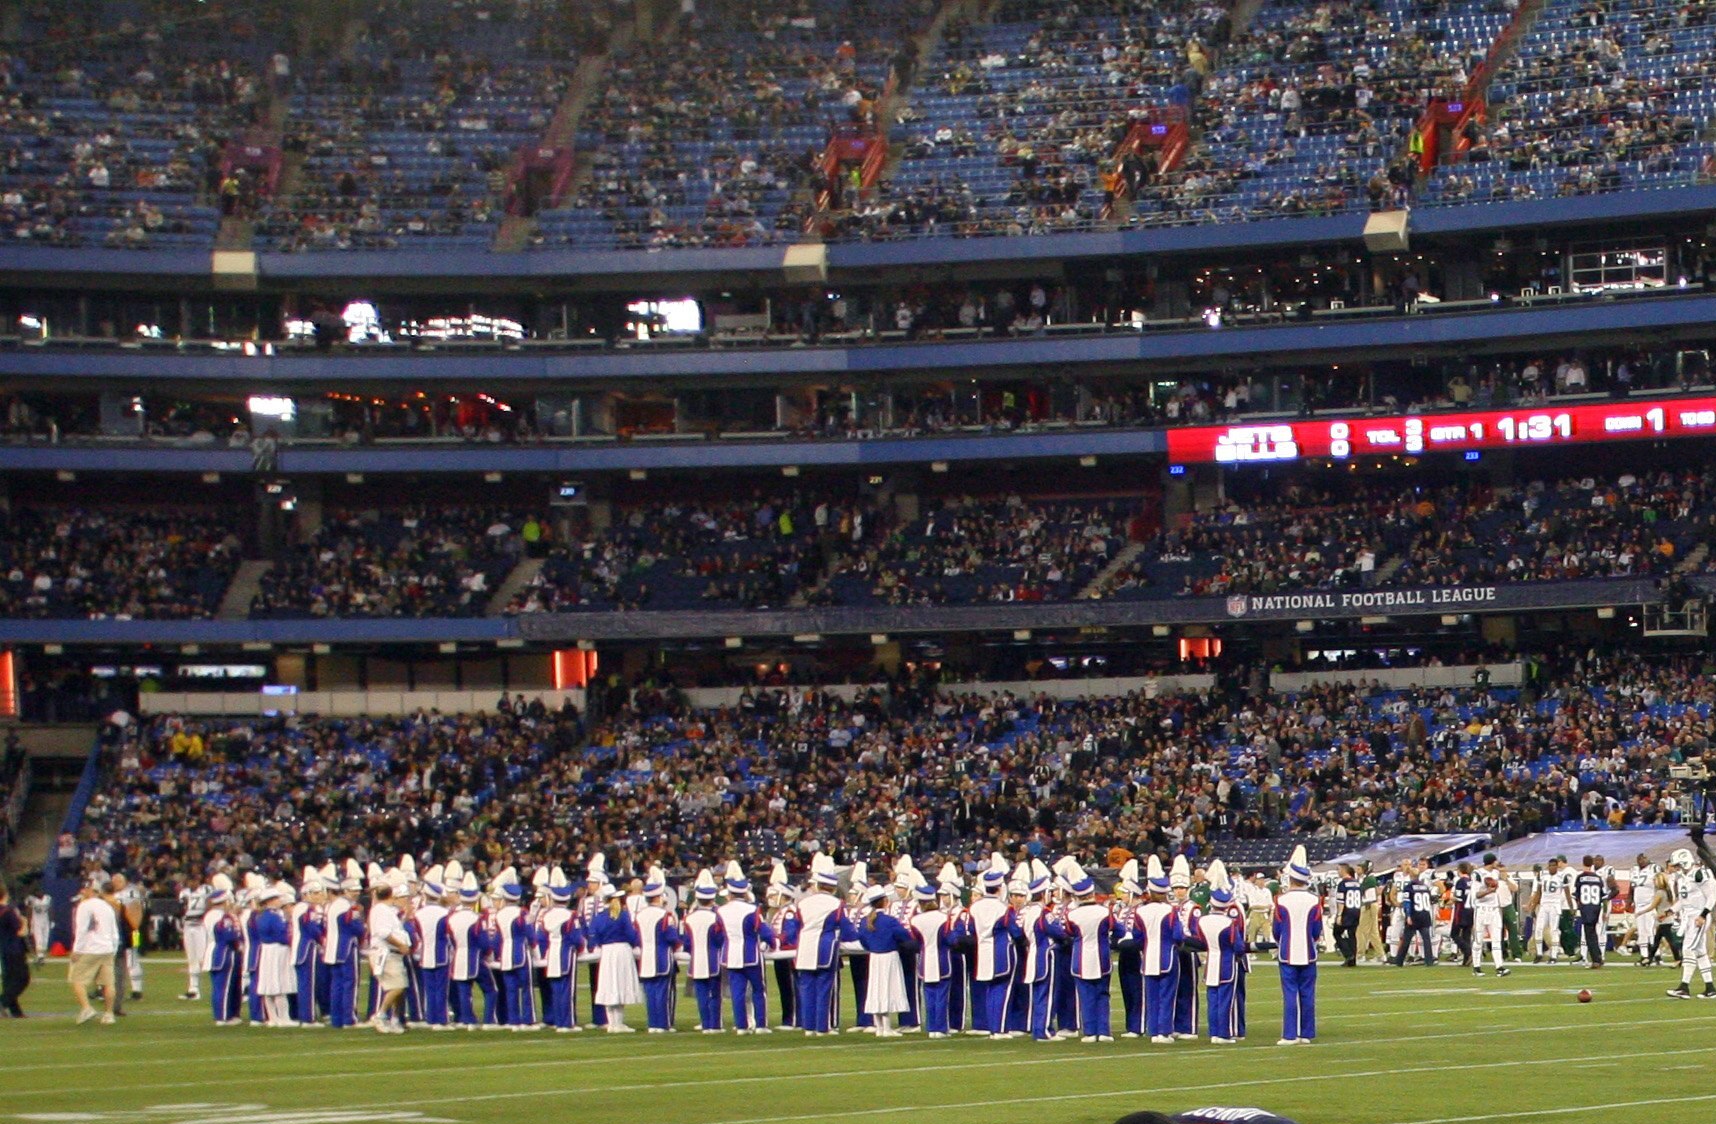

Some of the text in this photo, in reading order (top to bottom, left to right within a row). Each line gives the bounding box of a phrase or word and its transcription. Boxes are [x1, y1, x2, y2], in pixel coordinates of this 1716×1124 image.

[1405, 418, 1423, 435] 3
[1469, 423, 1484, 439] 1
[1497, 413, 1573, 441] 1:31
[1645, 408, 1665, 432] 1
[1218, 425, 1293, 444] JETS
[1330, 422, 1349, 440] 0
[1405, 435, 1423, 451] 3
[1252, 594, 1335, 611] NATIONAL
[1342, 590, 1425, 608] FOOTBALL
[1432, 586, 1496, 604] LEAGUE
[1542, 880, 1558, 893] 16
[1579, 884, 1602, 905] 89
[1345, 889, 1362, 909] 88
[1413, 892, 1431, 912] 90
